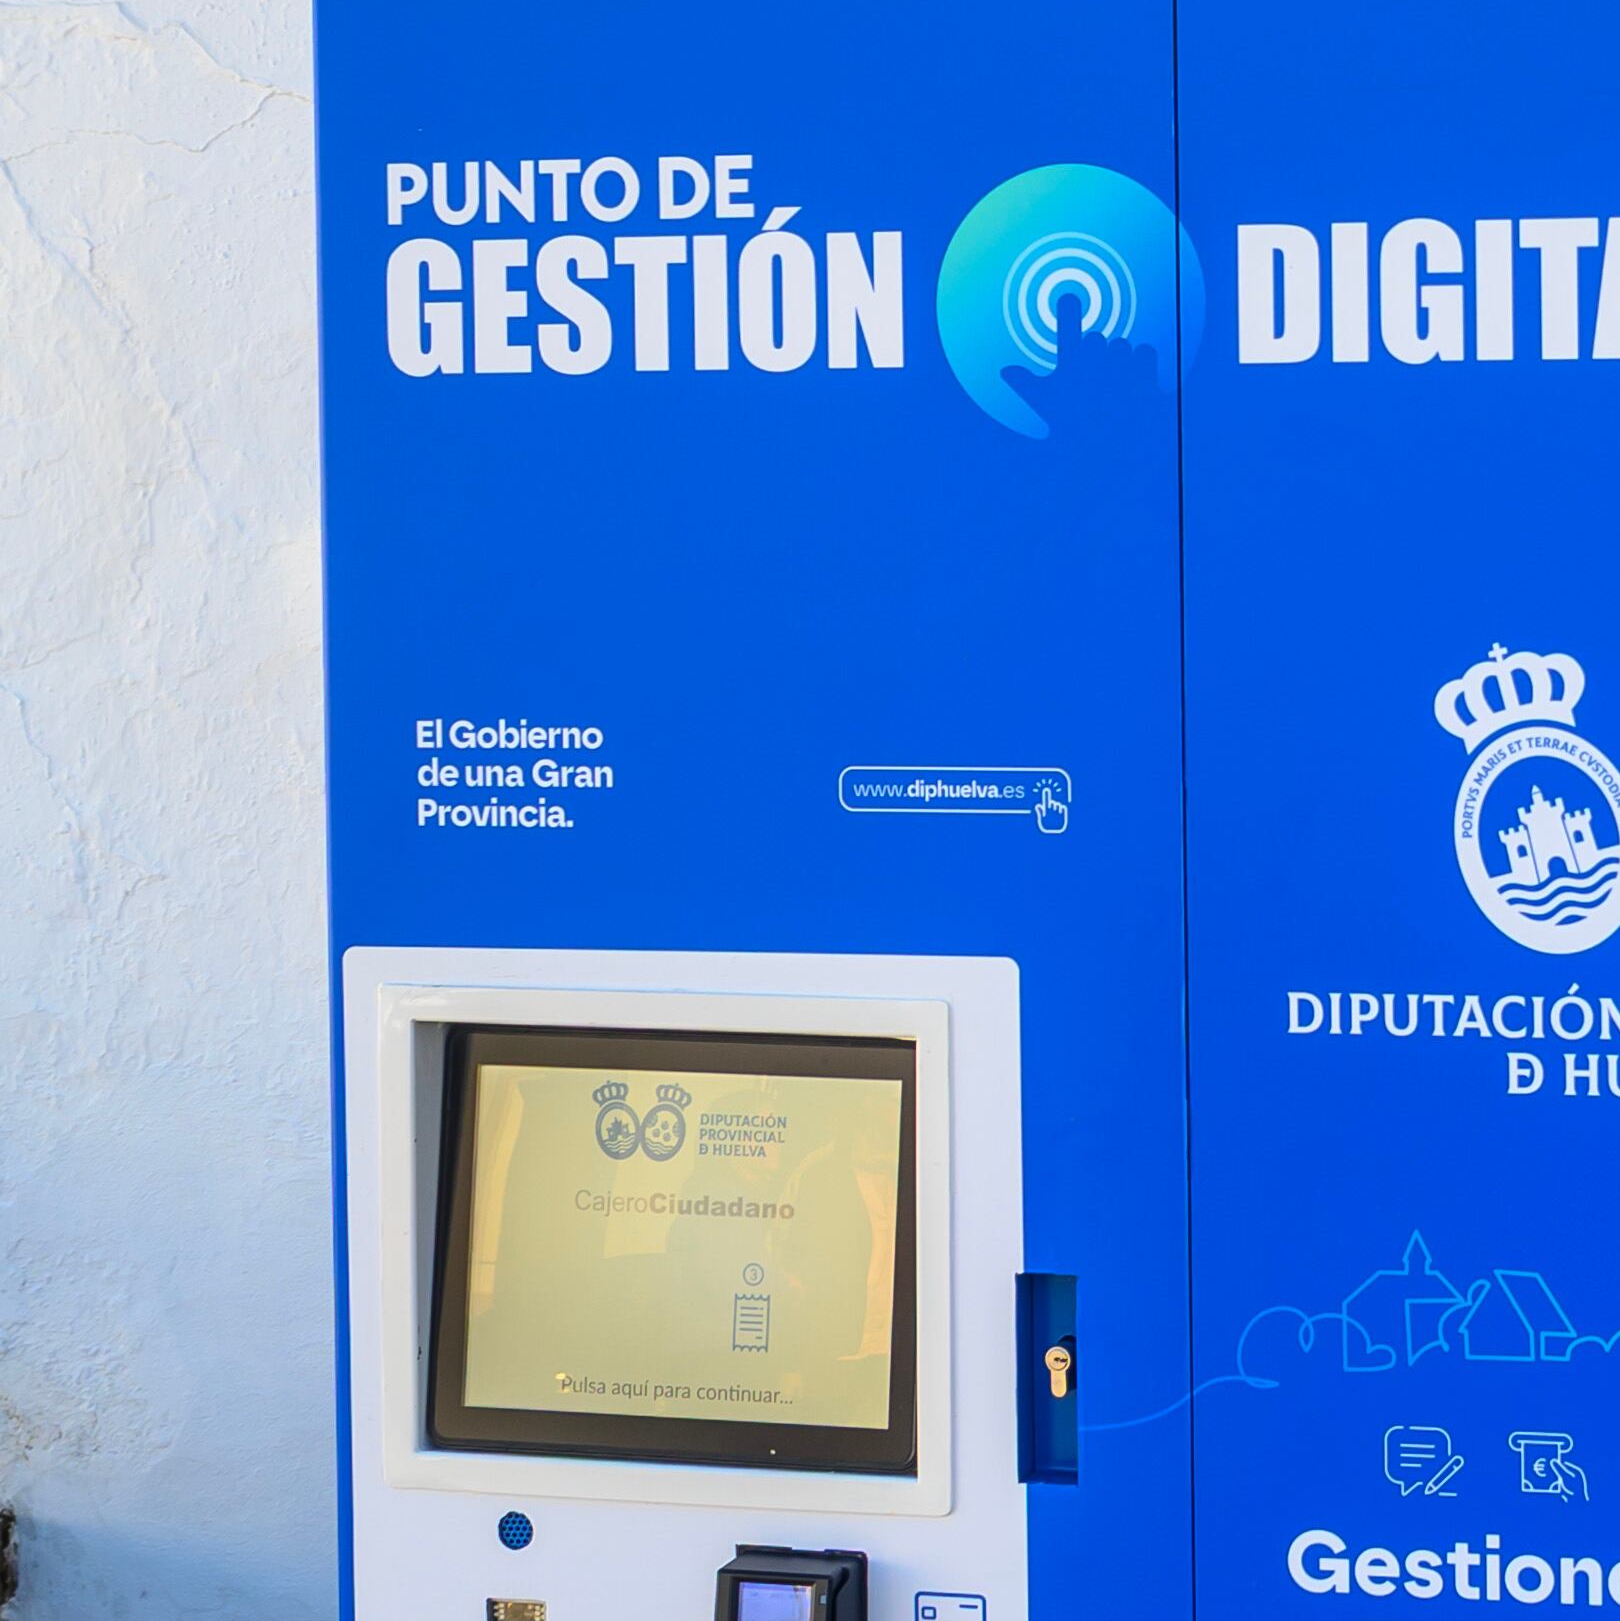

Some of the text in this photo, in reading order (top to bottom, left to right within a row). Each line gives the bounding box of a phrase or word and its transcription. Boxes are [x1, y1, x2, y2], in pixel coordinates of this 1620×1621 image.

[386, 154, 755, 226] PUNTO DE
[386, 206, 905, 378] GESTIÓN
[416, 718, 604, 750] El Gobierno
[417, 757, 613, 788] de una Gran
[1461, 787, 1480, 839] PORTVS
[1473, 748, 1507, 786] MARIS
[1507, 739, 1523, 755] ET
[1525, 736, 1578, 757] TERRAE
[853, 779, 1025, 802] www.diphuelva.es
[417, 797, 574, 828] Provincia.
[699, 1113, 787, 1129] DIPUTACIÓN
[699, 1127, 785, 1143] PROVINCIAL
[712, 1143, 767, 1158] HUELVA
[574, 1189, 795, 1220] CajeroCiudadano
[561, 1376, 794, 1405] Pulsa aquí para continuar...
